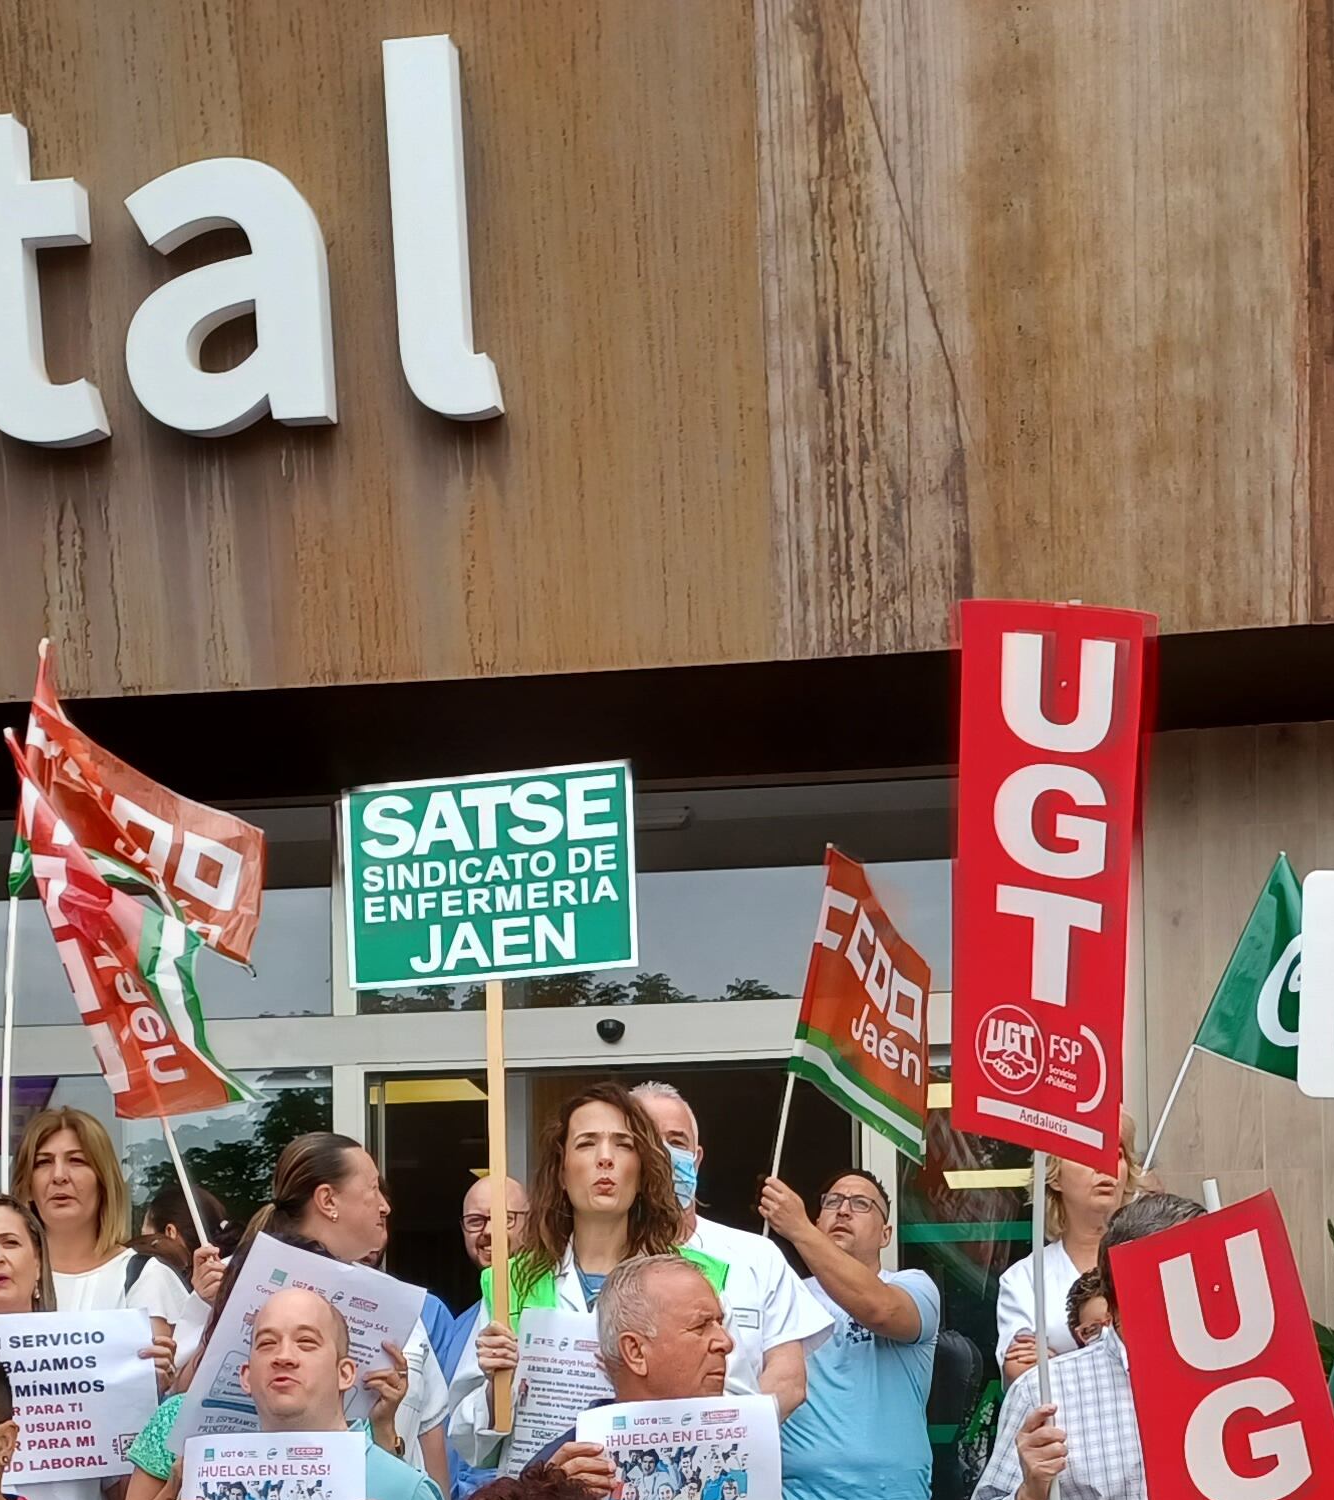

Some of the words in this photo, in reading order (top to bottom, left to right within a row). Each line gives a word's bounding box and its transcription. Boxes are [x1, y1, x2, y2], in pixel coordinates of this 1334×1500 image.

[361, 773, 619, 861] SATSE
[993, 631, 1117, 1008] UGT
[361, 850, 558, 893] SINDICATO
[569, 842, 618, 876] DE
[363, 875, 619, 924] ENFERMERIA
[408, 912, 578, 974] JAEN
[814, 885, 923, 1043] CCOO
[851, 1003, 921, 1086] Jaén
[986, 1018, 1035, 1058] UGT
[1049, 1034, 1083, 1065] FSP
[1049, 1064, 1077, 1081] Servicios
[9, 1331, 105, 1348] SERVICIO
[16, 1379, 105, 1397] MÍNIMOS
[25, 1403, 64, 1415] PARA
[68, 1402, 83, 1413] TI
[26, 1419, 92, 1434] USUARIO
[606, 1431, 668, 1448] ¡HUELGA
[673, 1430, 691, 1442] EN
[695, 1428, 712, 1441] EL
[27, 1438, 70, 1451] PARA
[76, 1436, 95, 1448] MI
[29, 1454, 108, 1472] LABORAL
[197, 1465, 255, 1478] ¡HUELGA
[259, 1465, 277, 1476] EN
[282, 1464, 297, 1476] EL
[301, 1464, 331, 1475] SAS!
